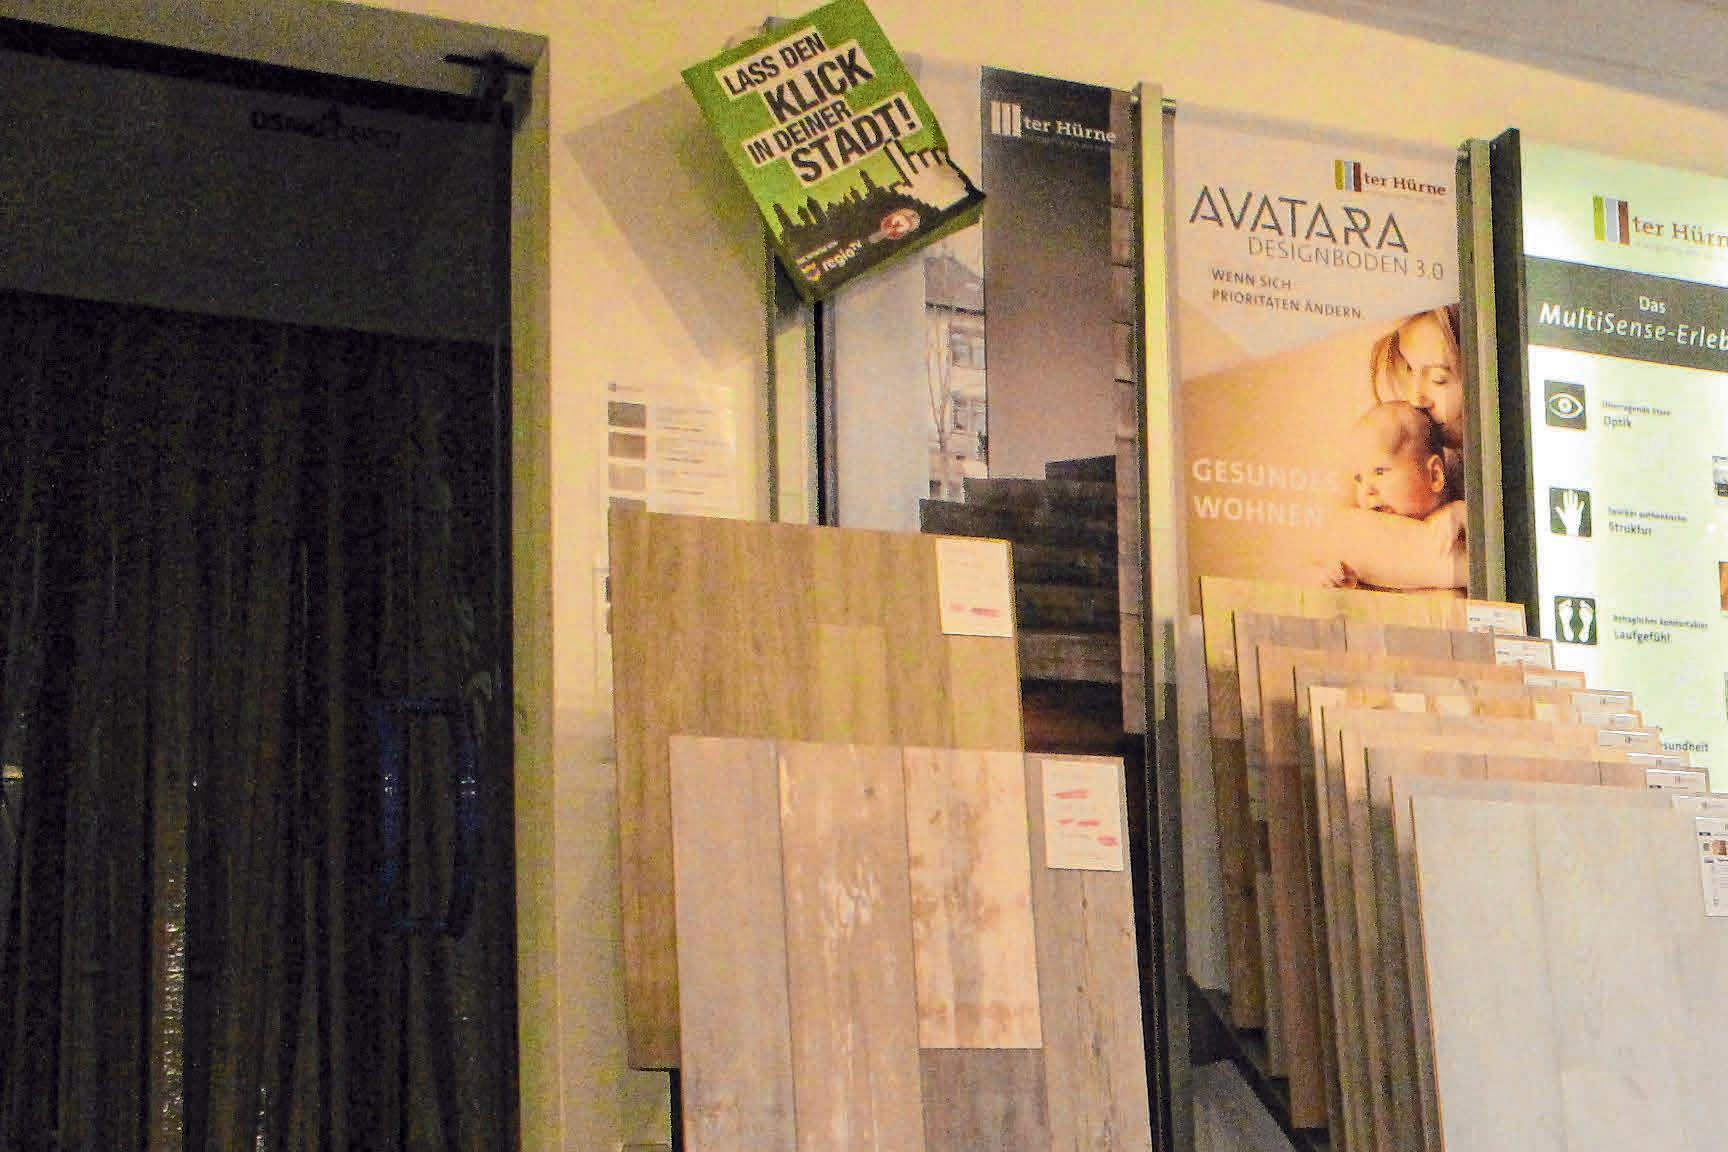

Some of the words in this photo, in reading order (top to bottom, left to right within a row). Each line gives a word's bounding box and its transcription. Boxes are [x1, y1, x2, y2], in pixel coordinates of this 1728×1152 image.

[723, 55, 780, 96] LASS
[783, 32, 826, 72] DEN
[761, 47, 874, 123] KLICK
[748, 137, 775, 165] IN
[777, 99, 853, 155] DEINER
[790, 96, 918, 183] STADT!
[1023, 117, 1051, 135] ter
[1055, 119, 1117, 143] Hürne
[1363, 171, 1386, 187] ter
[1393, 174, 1448, 196] Hürne
[1189, 184, 1409, 253] AVATARA
[1631, 215, 1664, 237] ter
[1211, 267, 1256, 287] WENN
[1258, 274, 1292, 291] SICH
[1247, 236, 1409, 276] DESIGNBODEN
[1415, 259, 1444, 280] 3.0
[1638, 295, 1666, 314] Das
